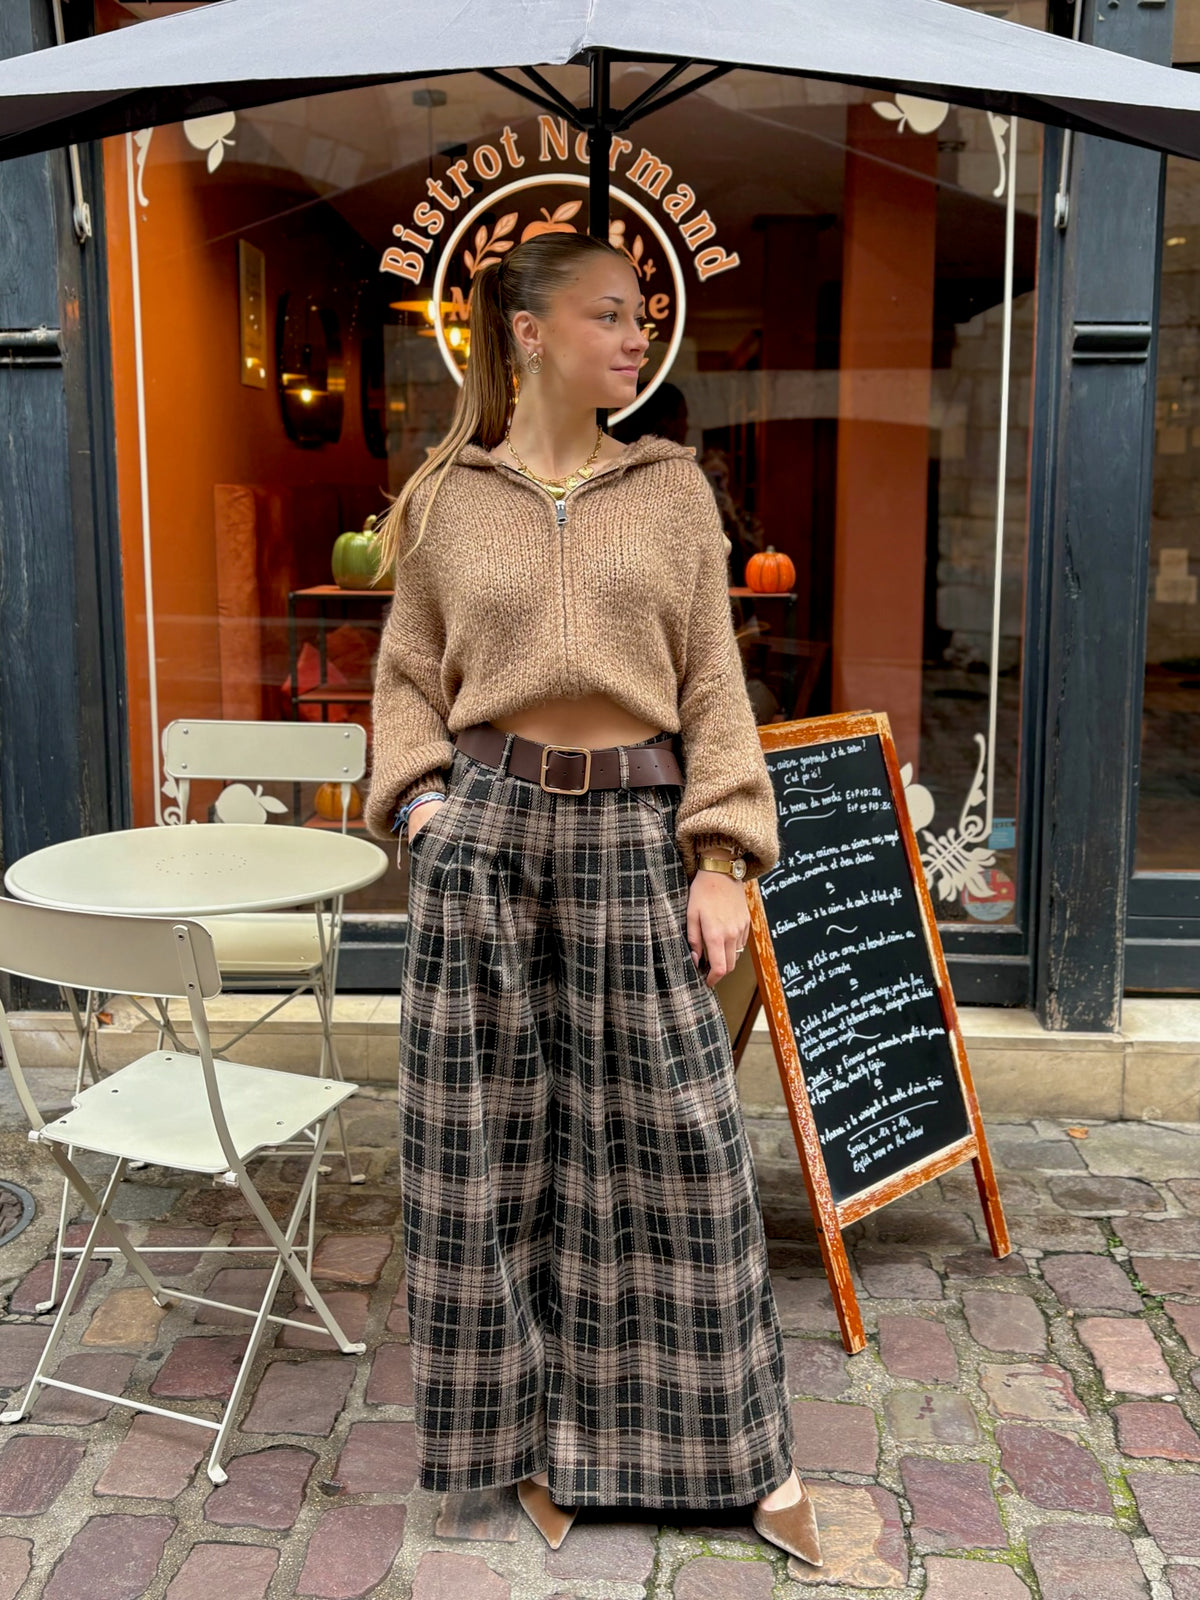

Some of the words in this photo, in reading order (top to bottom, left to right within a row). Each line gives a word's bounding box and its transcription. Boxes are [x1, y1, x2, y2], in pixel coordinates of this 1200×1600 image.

[379, 126, 526, 285] Bistrot
[777, 760, 799, 770] cuisine
[800, 750, 829, 771] gourmande
[830, 747, 837, 759] et
[838, 746, 846, 756] de
[784, 772, 800, 784] C'est
[802, 774, 810, 786] par
[778, 801, 789, 816] Le
[790, 802, 808, 814] menu
[810, 797, 820, 808] du
[822, 791, 842, 806] marché
[795, 850, 816, 864] Soupe
[840, 844, 851, 852] au
[830, 857, 838, 870] et
[813, 908, 820, 918] à
[820, 906, 828, 916] la
[846, 897, 854, 909] de
[870, 889, 878, 902] et
[906, 930, 916, 938] au
[818, 968, 826, 982] et
[800, 1014, 822, 1034] Salade
[822, 1002, 849, 1022] d'automne
[850, 999, 860, 1008] au
[838, 1018, 846, 1030] et
[844, 1121, 851, 1130] à
[850, 1114, 858, 1126] la
[868, 1134, 878, 1146] de
